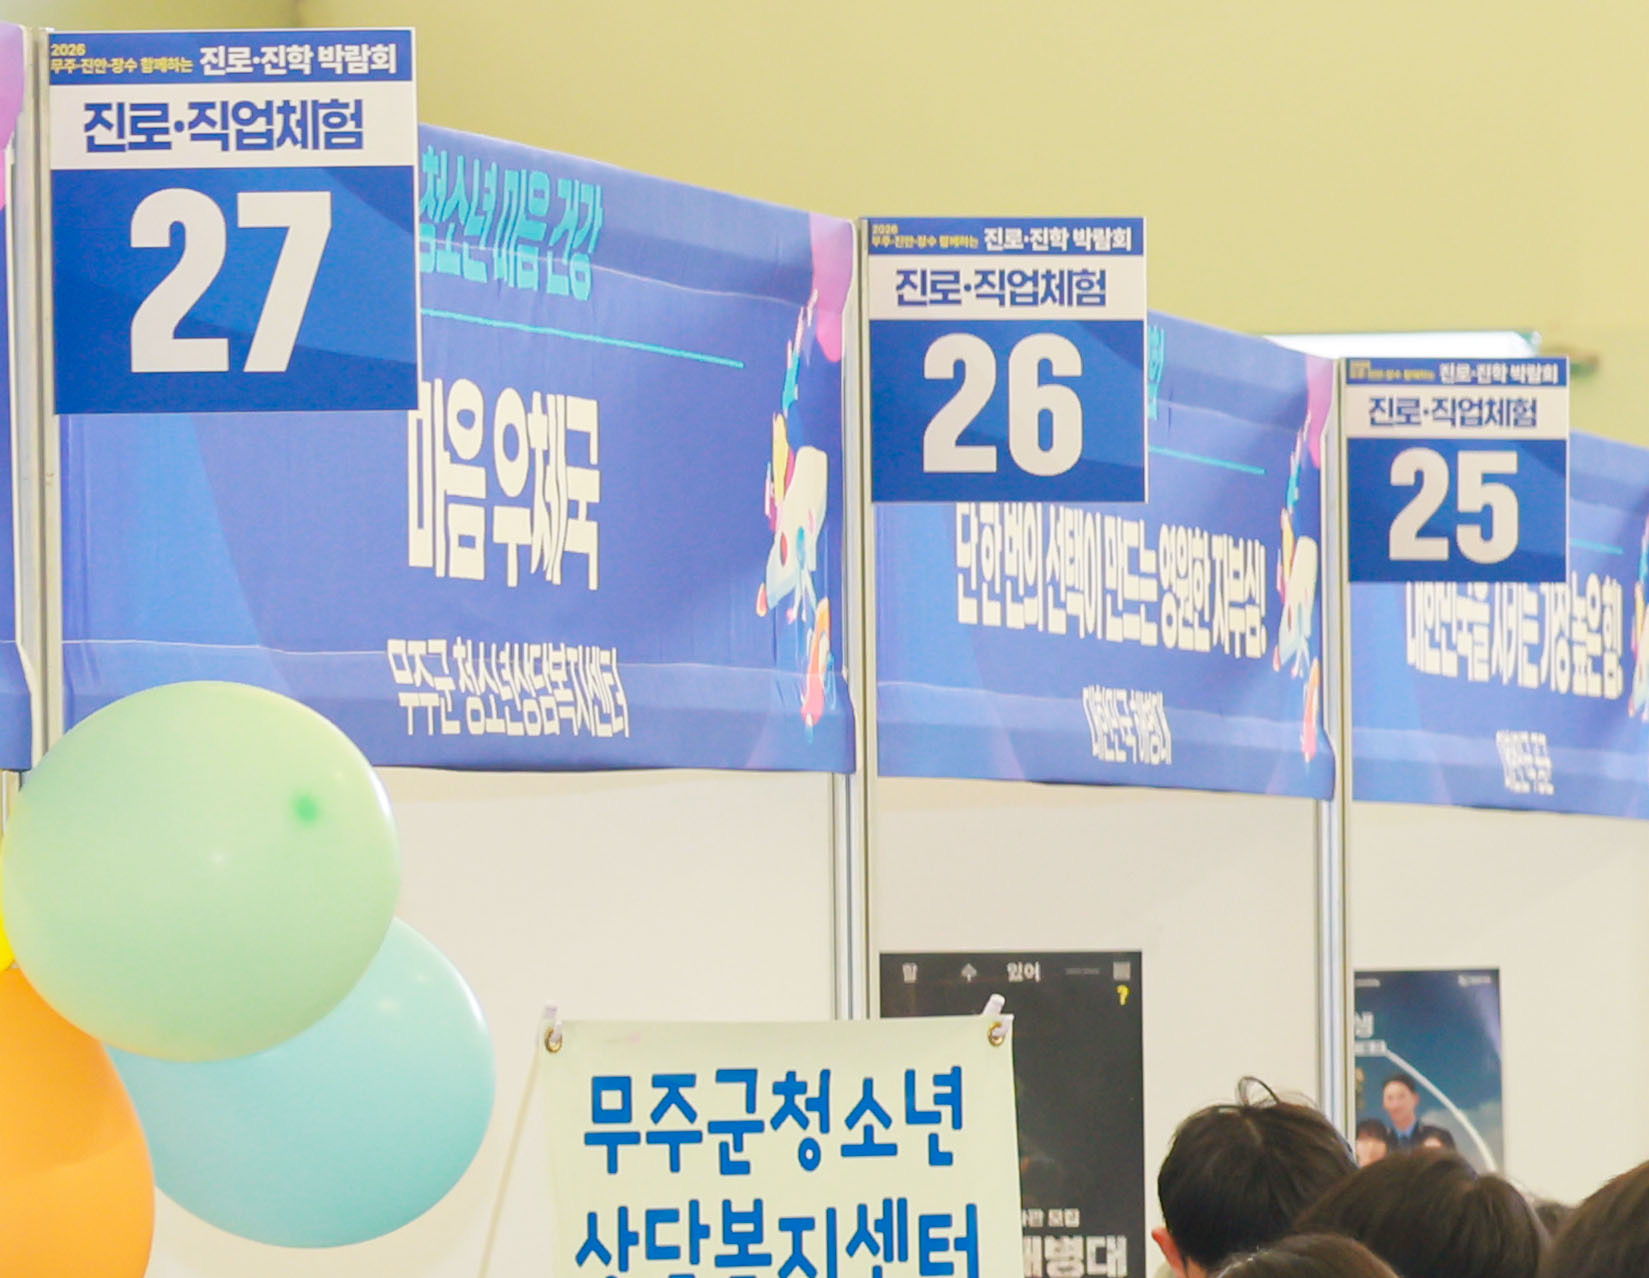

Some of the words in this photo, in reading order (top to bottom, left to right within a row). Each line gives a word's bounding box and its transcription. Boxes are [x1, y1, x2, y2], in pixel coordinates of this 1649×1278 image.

[200, 45, 313, 75] 진로·진학
[317, 43, 397, 74] 박람회
[83, 99, 364, 153] 진로·직업체험
[129, 188, 333, 374] 27
[984, 227, 1069, 251] 진로·진학
[896, 268, 1107, 309] 진로·직업체험
[923, 332, 1083, 477] 26
[1368, 396, 1537, 428] 진로·직업체험
[407, 378, 486, 580] 마음
[493, 387, 600, 590] 우체국
[1388, 447, 1519, 565] 25
[387, 638, 461, 736] 무주군
[584, 1065, 963, 1176] 무주군청소년
